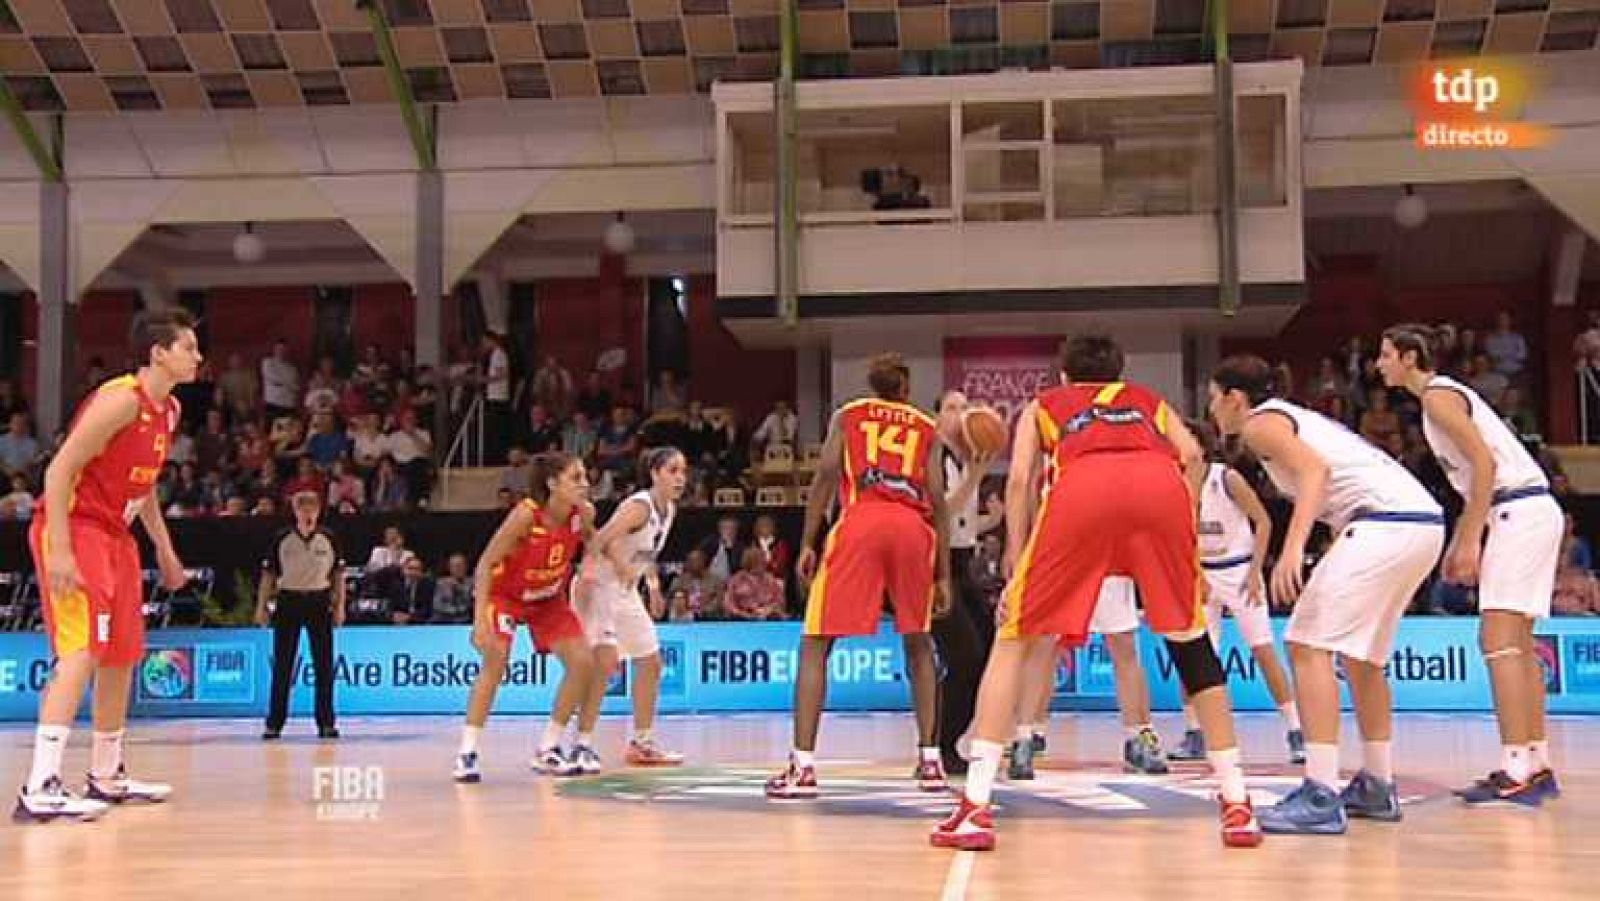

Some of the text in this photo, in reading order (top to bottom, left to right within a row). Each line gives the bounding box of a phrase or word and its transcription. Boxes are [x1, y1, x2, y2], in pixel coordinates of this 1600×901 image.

[860, 422, 919, 476] 14
[0, 659, 58, 691] E.C
[206, 650, 245, 671] FIBA
[333, 654, 381, 686] Are
[393, 652, 547, 686] Baskeall
[701, 650, 901, 683] FIBAEOPE.
